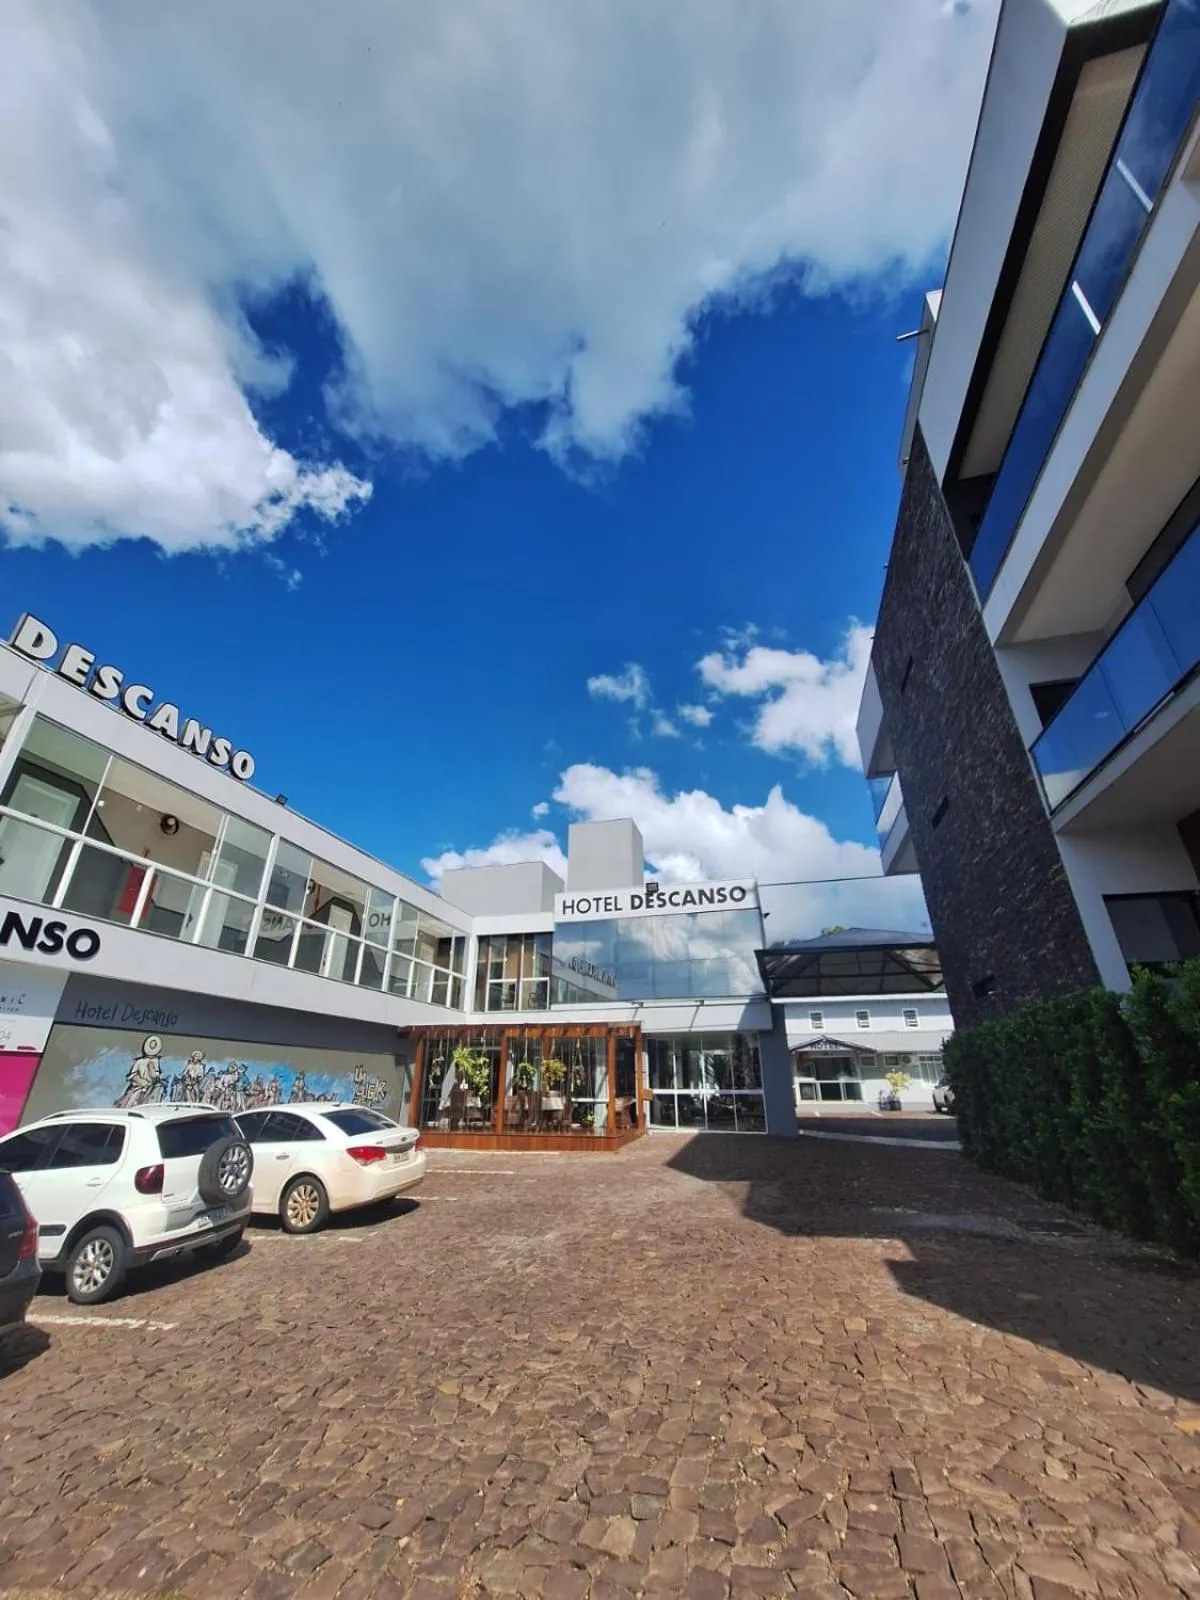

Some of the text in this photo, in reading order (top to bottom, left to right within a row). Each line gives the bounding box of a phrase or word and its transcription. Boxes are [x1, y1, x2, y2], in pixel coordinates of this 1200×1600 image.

[11, 612, 256, 781] DESCANSO
[562, 885, 747, 915] HOTEL DESCANSO
[0, 911, 101, 960] NSO
[75, 1000, 118, 1021] Hotel
